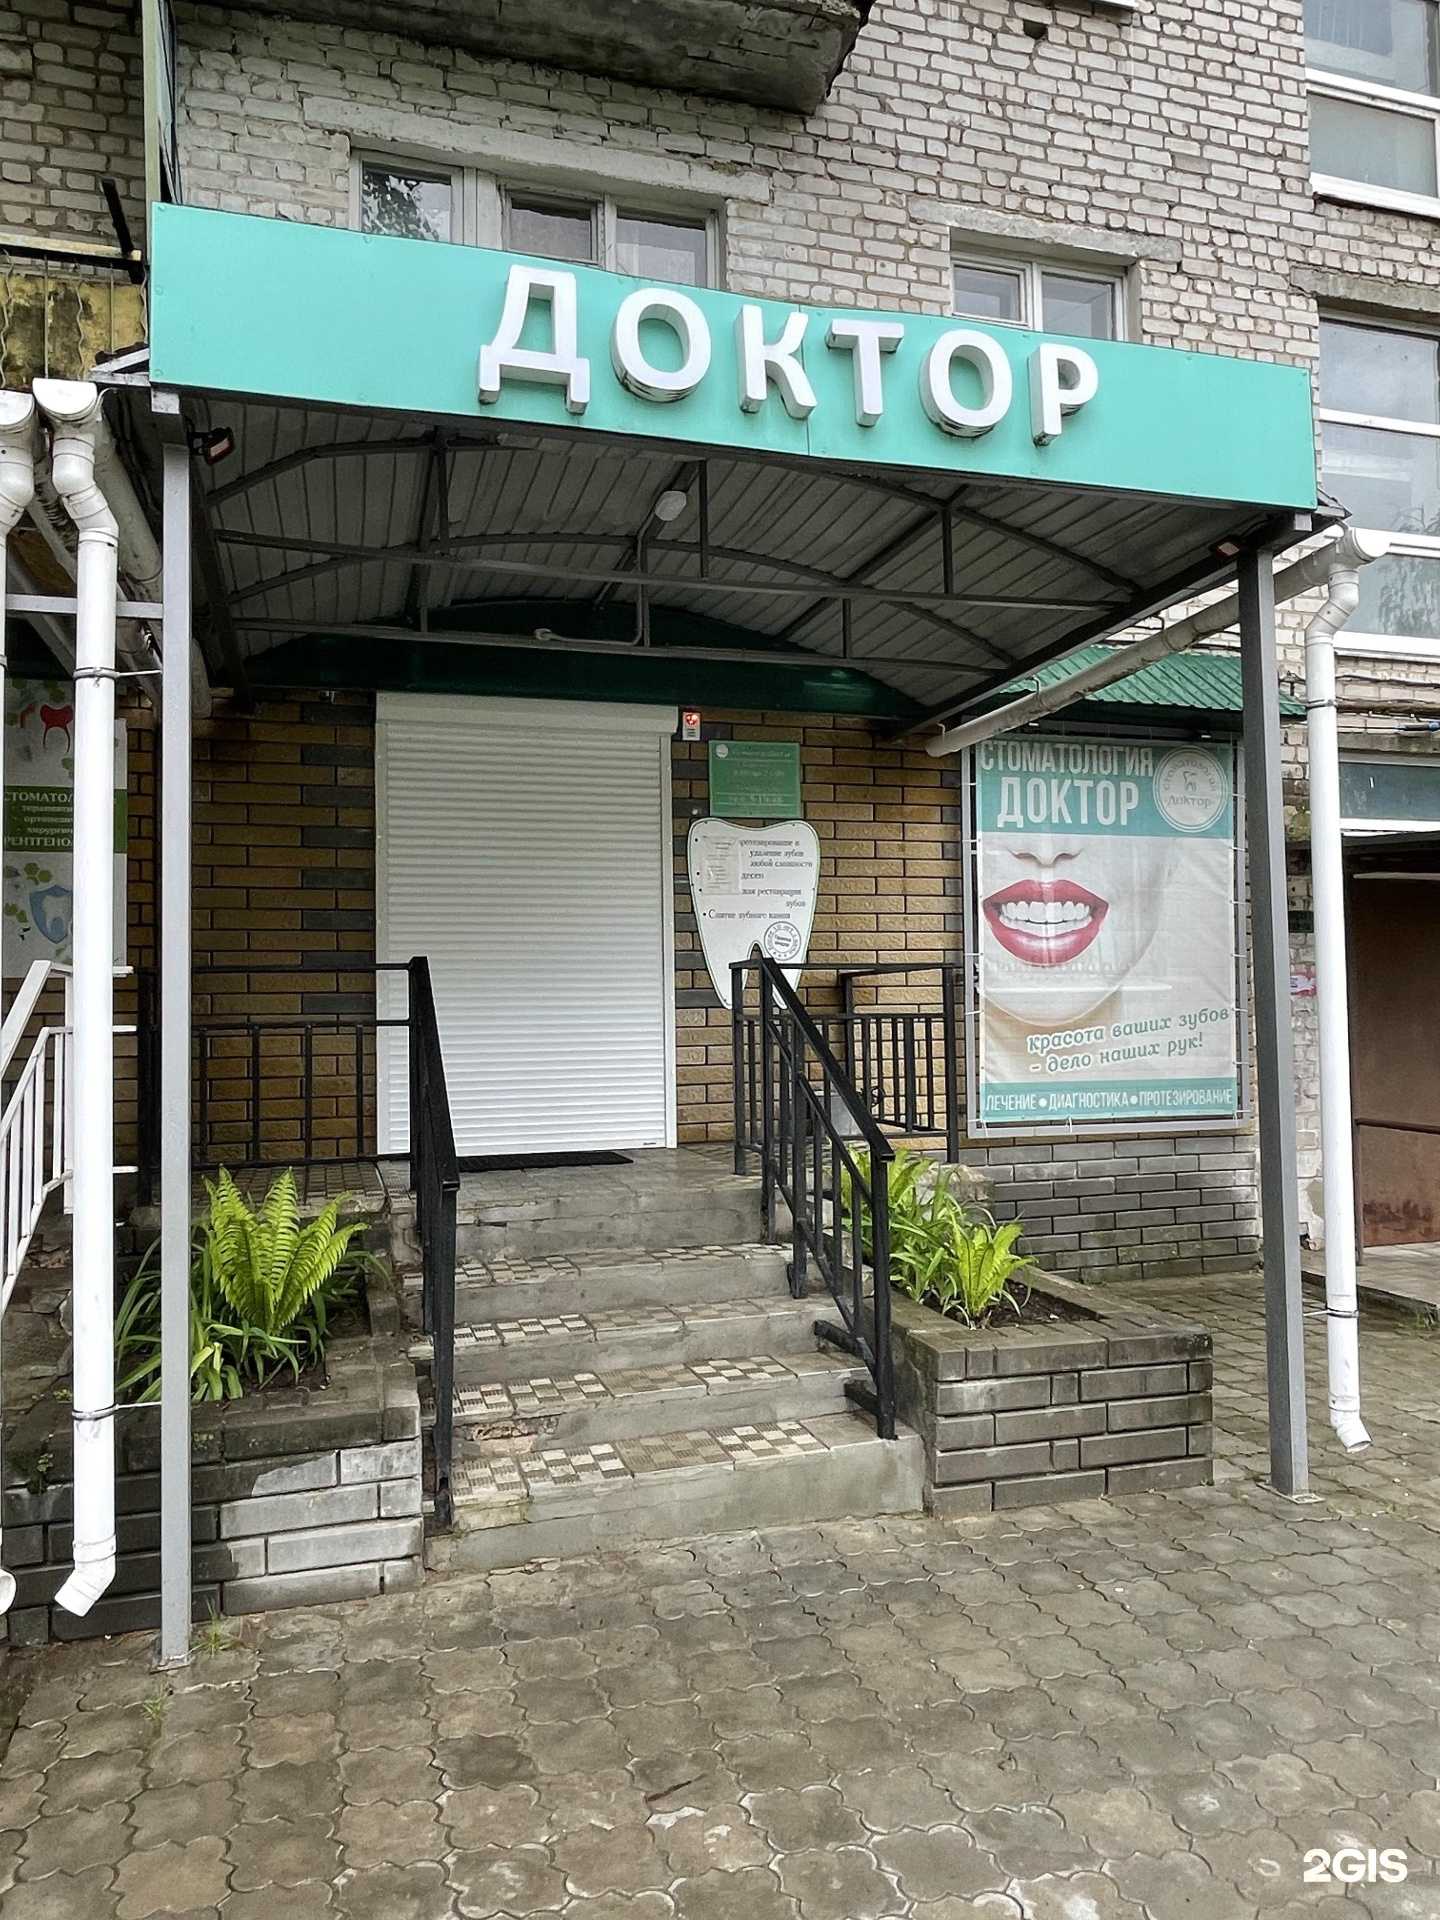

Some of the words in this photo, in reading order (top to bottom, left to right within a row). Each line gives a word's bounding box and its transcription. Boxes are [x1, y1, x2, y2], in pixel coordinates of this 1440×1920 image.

[478, 264, 1101, 446] ДОКТОР
[981, 740, 1154, 777] СТОМАТОЛОГИЯ
[996, 776, 1139, 828] ДОКТОР
[1028, 1027, 1104, 1053] красота
[1112, 1018, 1172, 1038] ваших
[1178, 1007, 1230, 1031] зубов
[1047, 1055, 1092, 1073] дело
[1099, 1044, 1161, 1065] наших
[1167, 1032, 1204, 1057] рук!
[985, 1092, 1037, 1112] ЛЕЧЕНИЕ
[1048, 1090, 1130, 1112] ДИАГНОСТИКА
[1137, 1088, 1233, 1107] ПРОТЕЗИРОВАНИЕ
